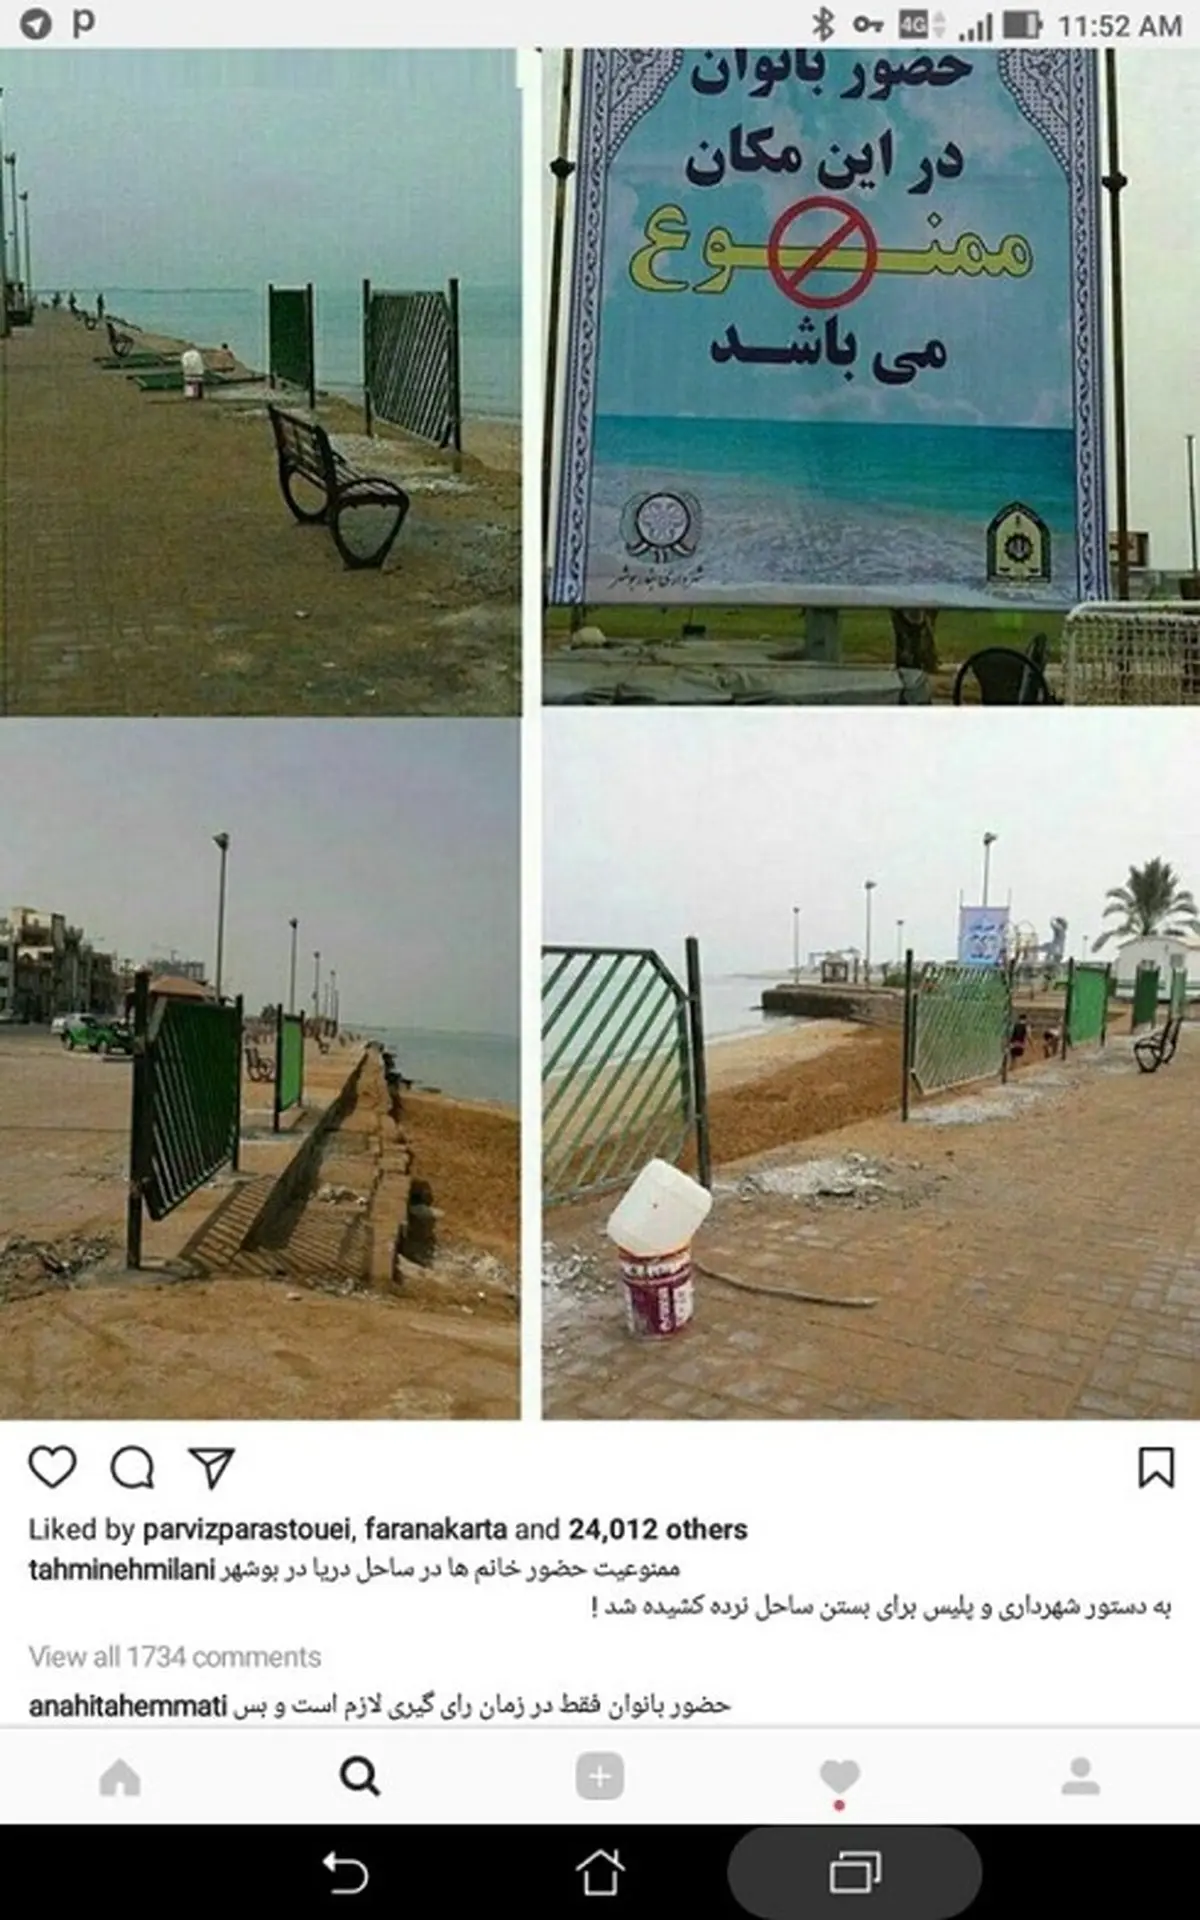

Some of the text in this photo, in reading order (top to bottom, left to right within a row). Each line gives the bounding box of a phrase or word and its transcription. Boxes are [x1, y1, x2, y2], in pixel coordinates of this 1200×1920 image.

[900, 12, 928, 36] 4G
[1058, 14, 1183, 38] 11:52 AM
[840, 52, 974, 101] حضور
[685, 124, 964, 194] در این مکان
[628, 203, 1034, 294] ممنوع
[709, 314, 948, 384] می باشد
[29, 1516, 748, 1547] Liked by parvizparastouei, faranakarta and 24,012 others
[28, 1556, 216, 1581] tahminehmilani
[219, 1555, 681, 1585] ممنوعیت حضور خانم ها در ساحل دریا در بوشهر
[592, 1593, 1172, 1622] به دستور شهرداری و پلیس برای بستن ساحل نرده کشیده شد !
[28, 1644, 322, 1669] View all 1734 comments
[28, 1692, 228, 1718] anahitahemmati
[233, 1690, 731, 1721] حضور بانوان فقط در زمان رای گیری لازم است و بس
